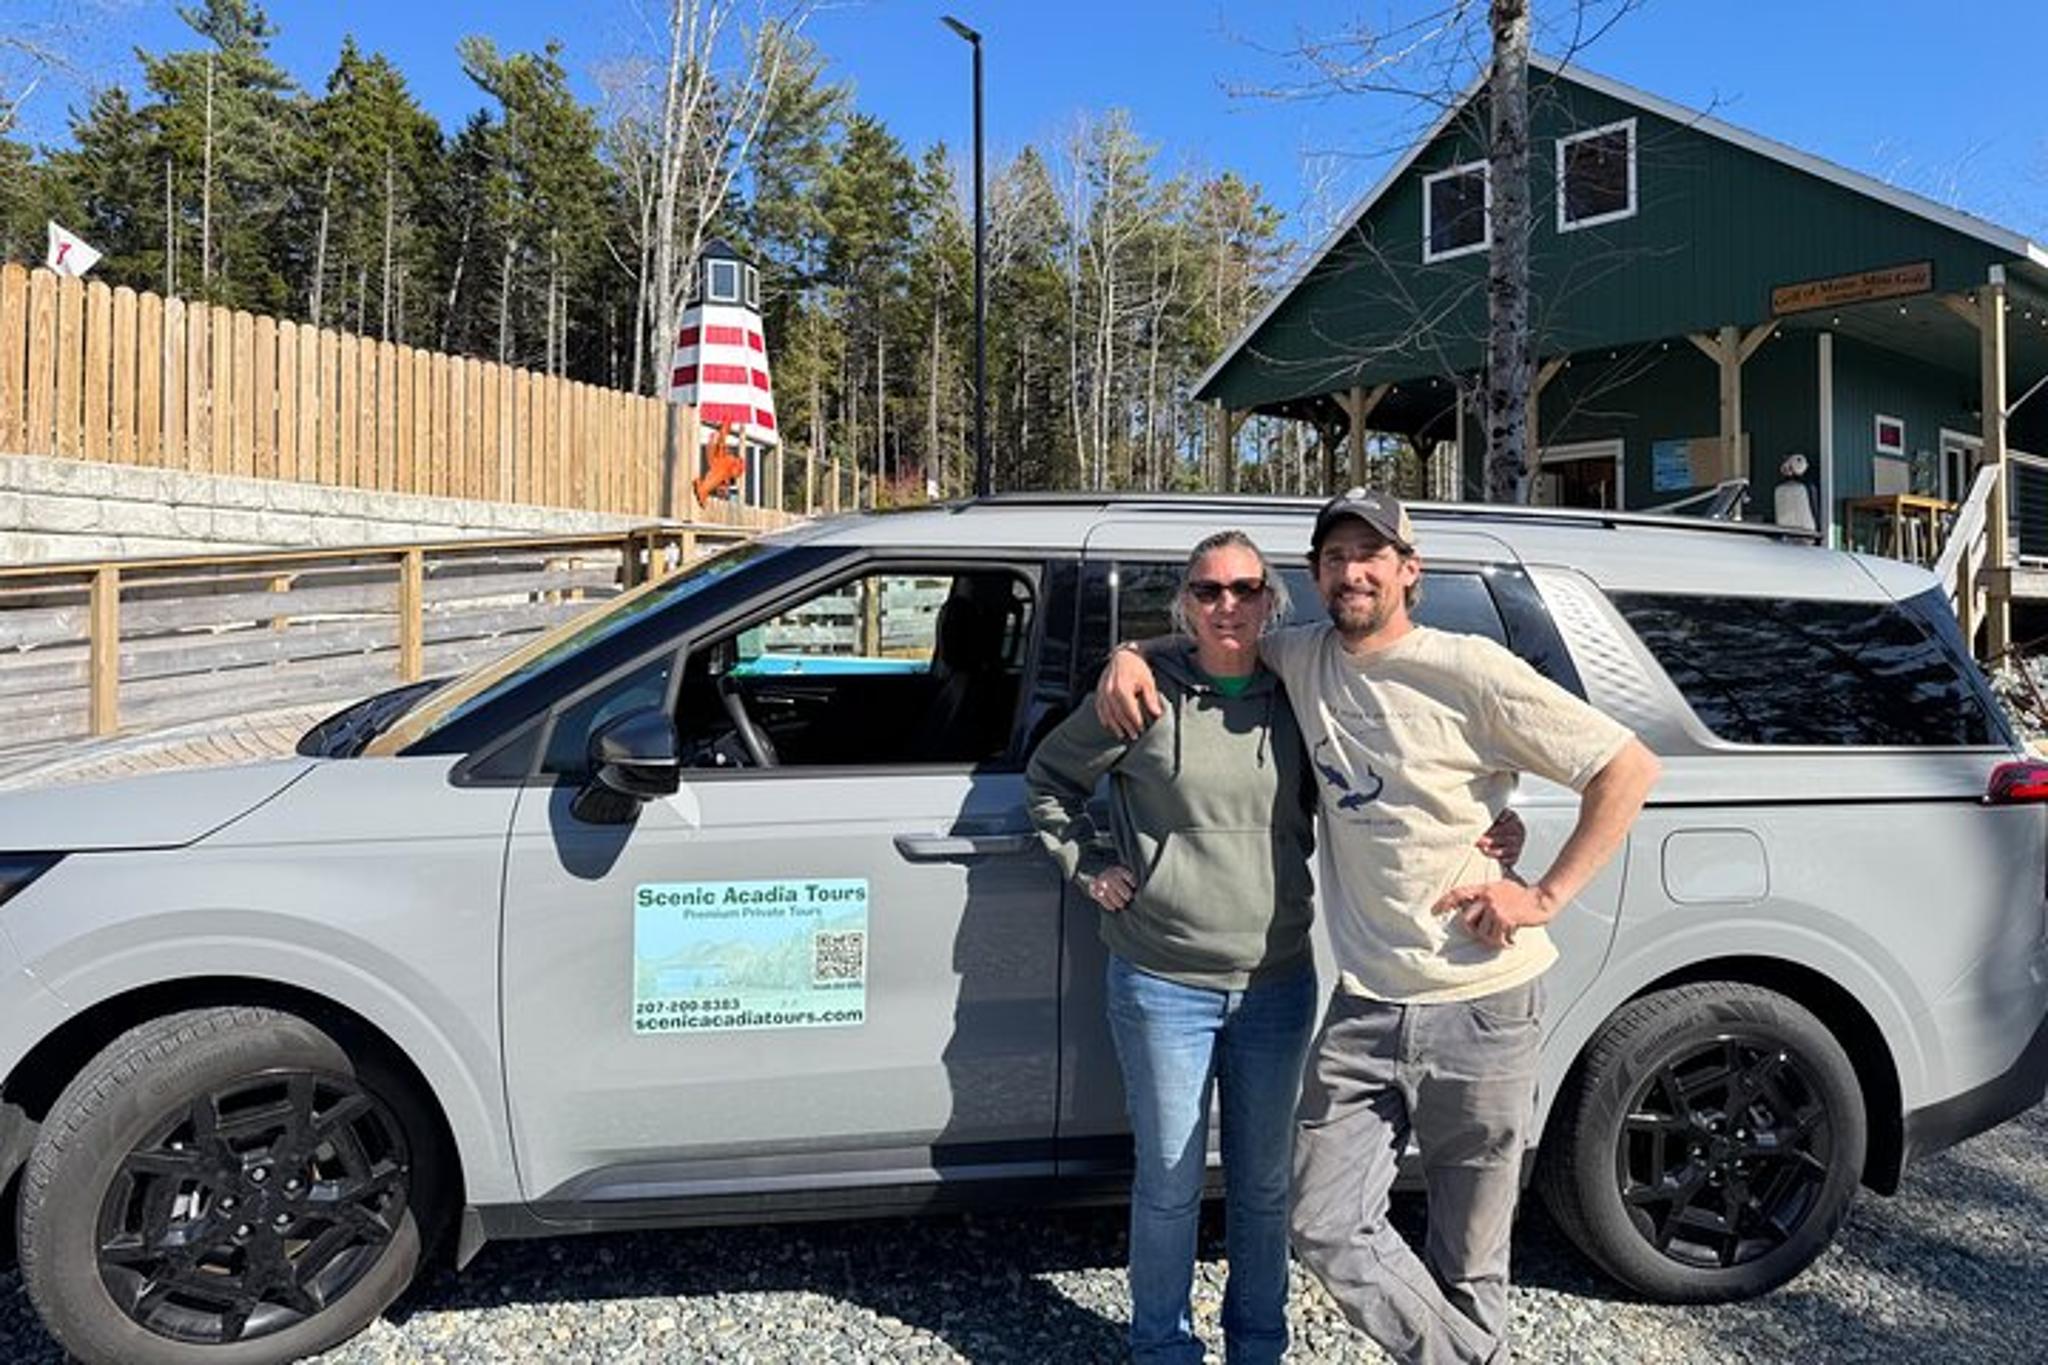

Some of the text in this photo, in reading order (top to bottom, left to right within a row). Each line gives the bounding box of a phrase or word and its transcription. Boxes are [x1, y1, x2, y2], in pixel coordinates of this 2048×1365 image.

[638, 884, 866, 908] Scenic Acadia Tours
[682, 905, 822, 920] Premium Private Tours
[635, 1008, 863, 1031] scenicacadiatours.com
